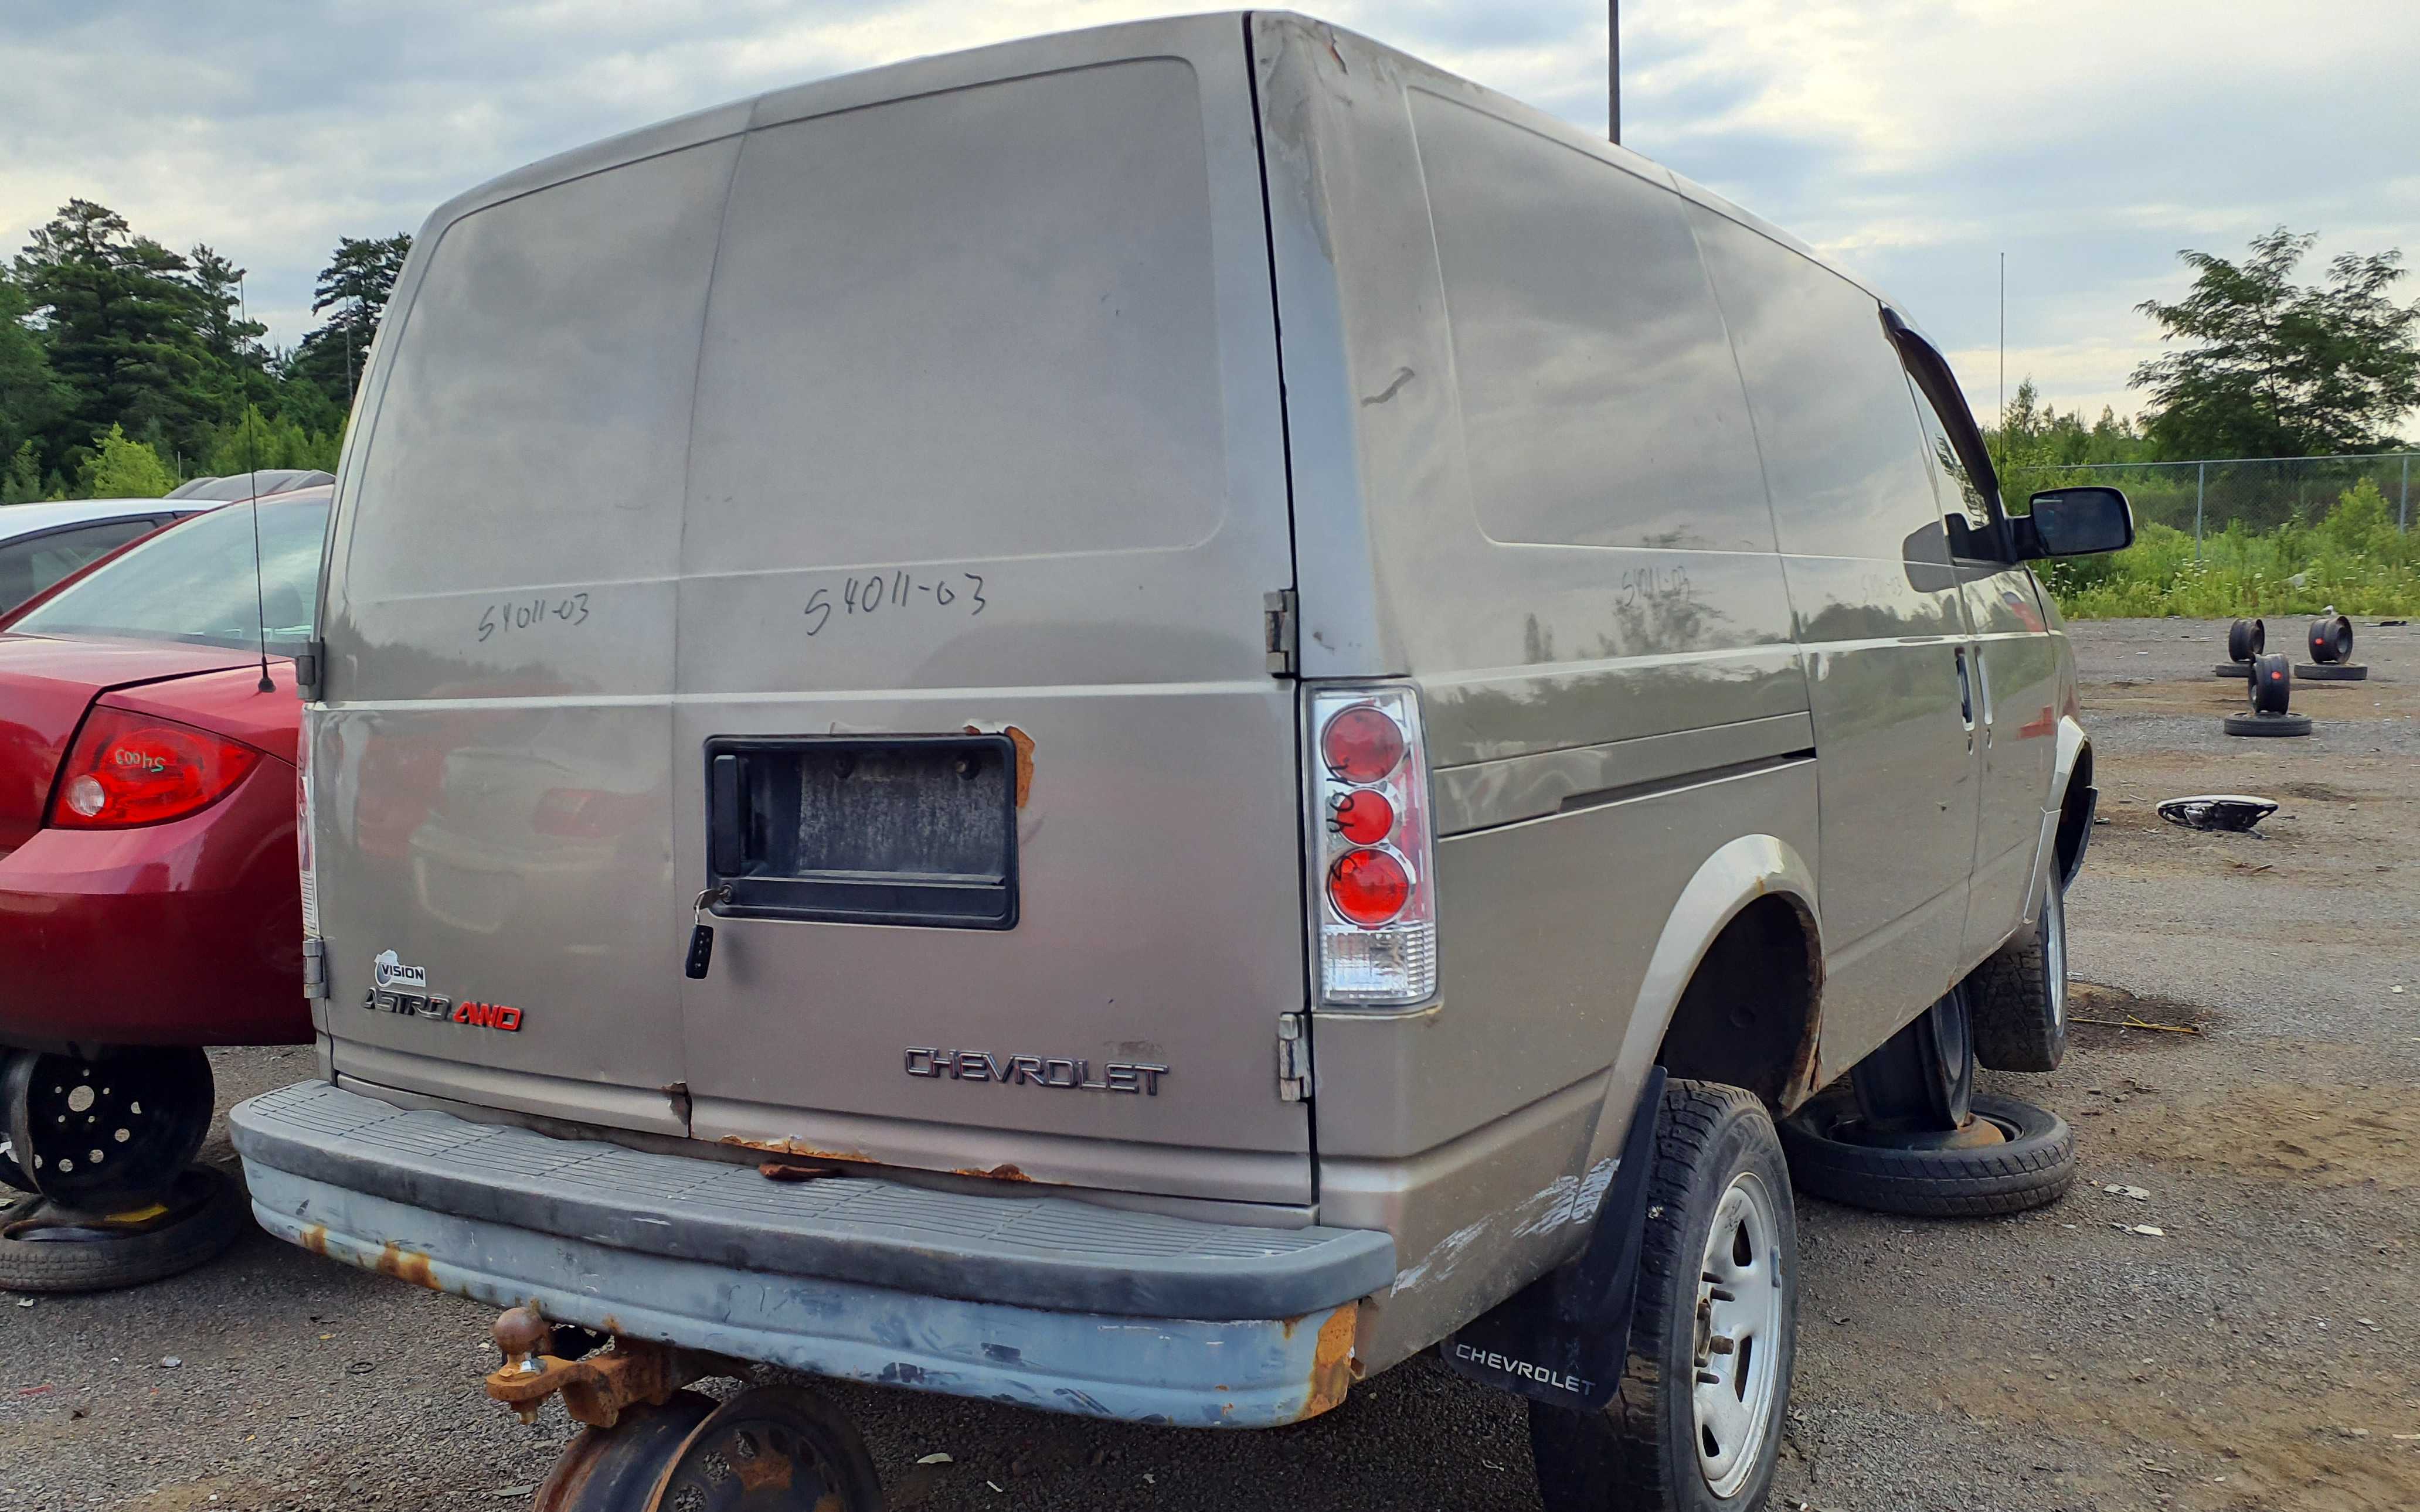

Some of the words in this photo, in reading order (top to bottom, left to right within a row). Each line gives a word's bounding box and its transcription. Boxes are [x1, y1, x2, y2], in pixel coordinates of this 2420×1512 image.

[381, 964, 424, 981] VISION
[362, 987, 452, 1021] ASTRO
[453, 1001, 523, 1032] AWD
[905, 1046, 1169, 1096] CHEVROLET
[1455, 1343, 1596, 1395] CHEVROLET
